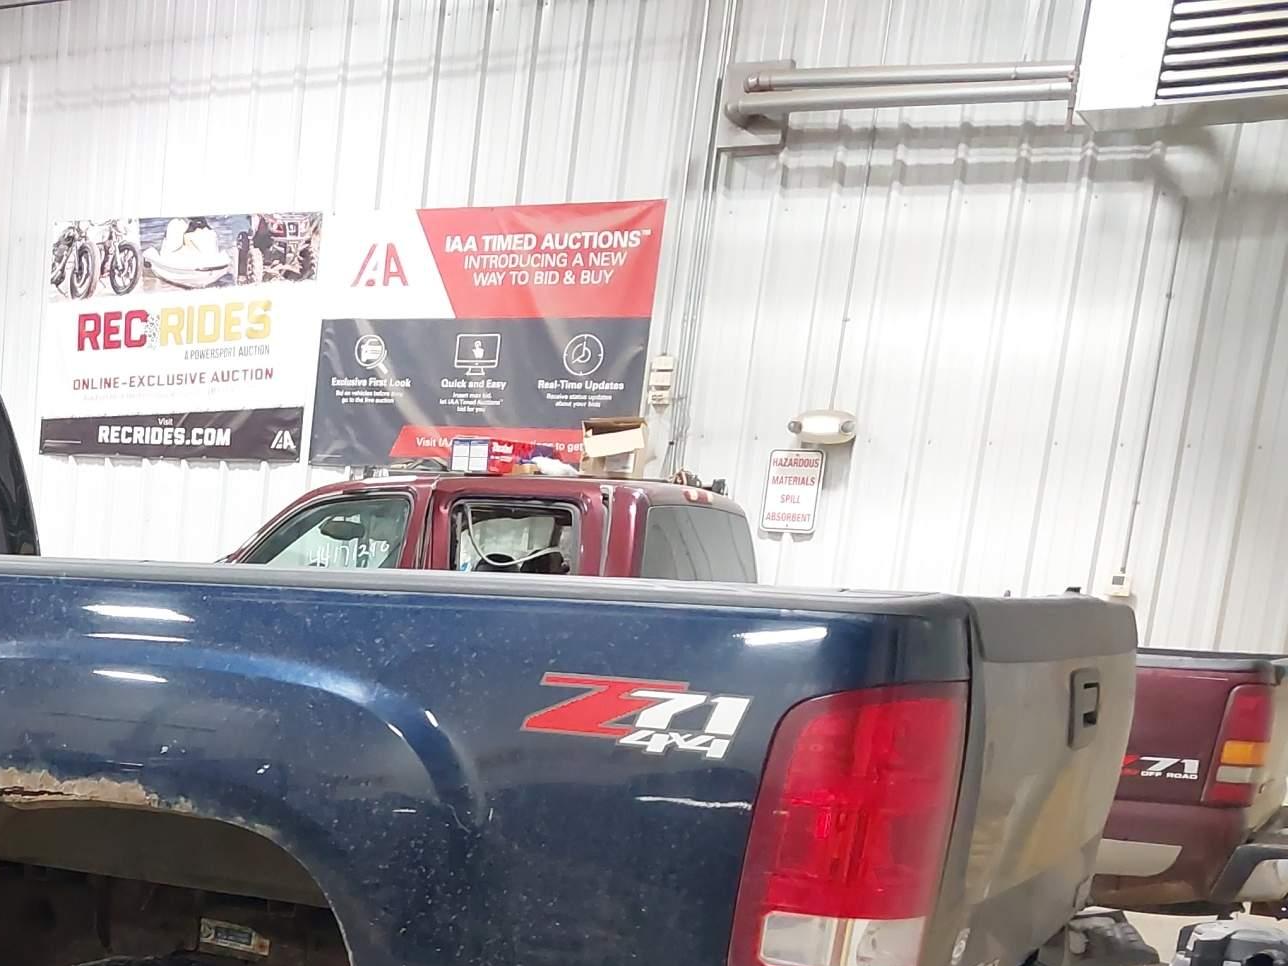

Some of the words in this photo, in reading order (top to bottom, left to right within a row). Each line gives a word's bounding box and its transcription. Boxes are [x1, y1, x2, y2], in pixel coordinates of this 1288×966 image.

[445, 235, 478, 253] IAA
[483, 233, 537, 251] TIMED
[464, 253, 569, 269] INTRODUCING
[572, 253, 583, 267] A
[588, 252, 627, 267] NEW
[473, 271, 505, 286] WAY
[510, 271, 529, 285] TO
[534, 271, 560, 286] BID
[563, 270, 575, 285] &
[580, 269, 614, 285] BUY
[77, 309, 149, 352] REC
[159, 299, 272, 347] RIDES
[238, 343, 271, 357] AUCTION
[73, 372, 206, 391] ONLINE-EXCLUSIVE
[211, 368, 274, 384] AUCTION
[331, 377, 368, 388] Exclusive
[368, 377, 387, 387] First
[389, 377, 412, 388] Look
[441, 379, 467, 389] Quick
[468, 379, 485, 389] and
[486, 379, 508, 391] Easy
[537, 380, 583, 390] Real-Time
[584, 380, 624, 392] Updates
[158, 417, 173, 426] Visit
[97, 425, 232, 447] RECRIDES.COM
[416, 437, 436, 447] Visit
[555, 442, 565, 451] to
[772, 457, 820, 468] HAZARDOUS
[771, 475, 816, 487] MATERIALS
[779, 494, 800, 504] SPILL
[765, 511, 811, 523] ABSORBENT
[520, 671, 754, 739] Z71
[1140, 770, 1163, 778] OFF
[1165, 772, 1199, 780] ROAD
